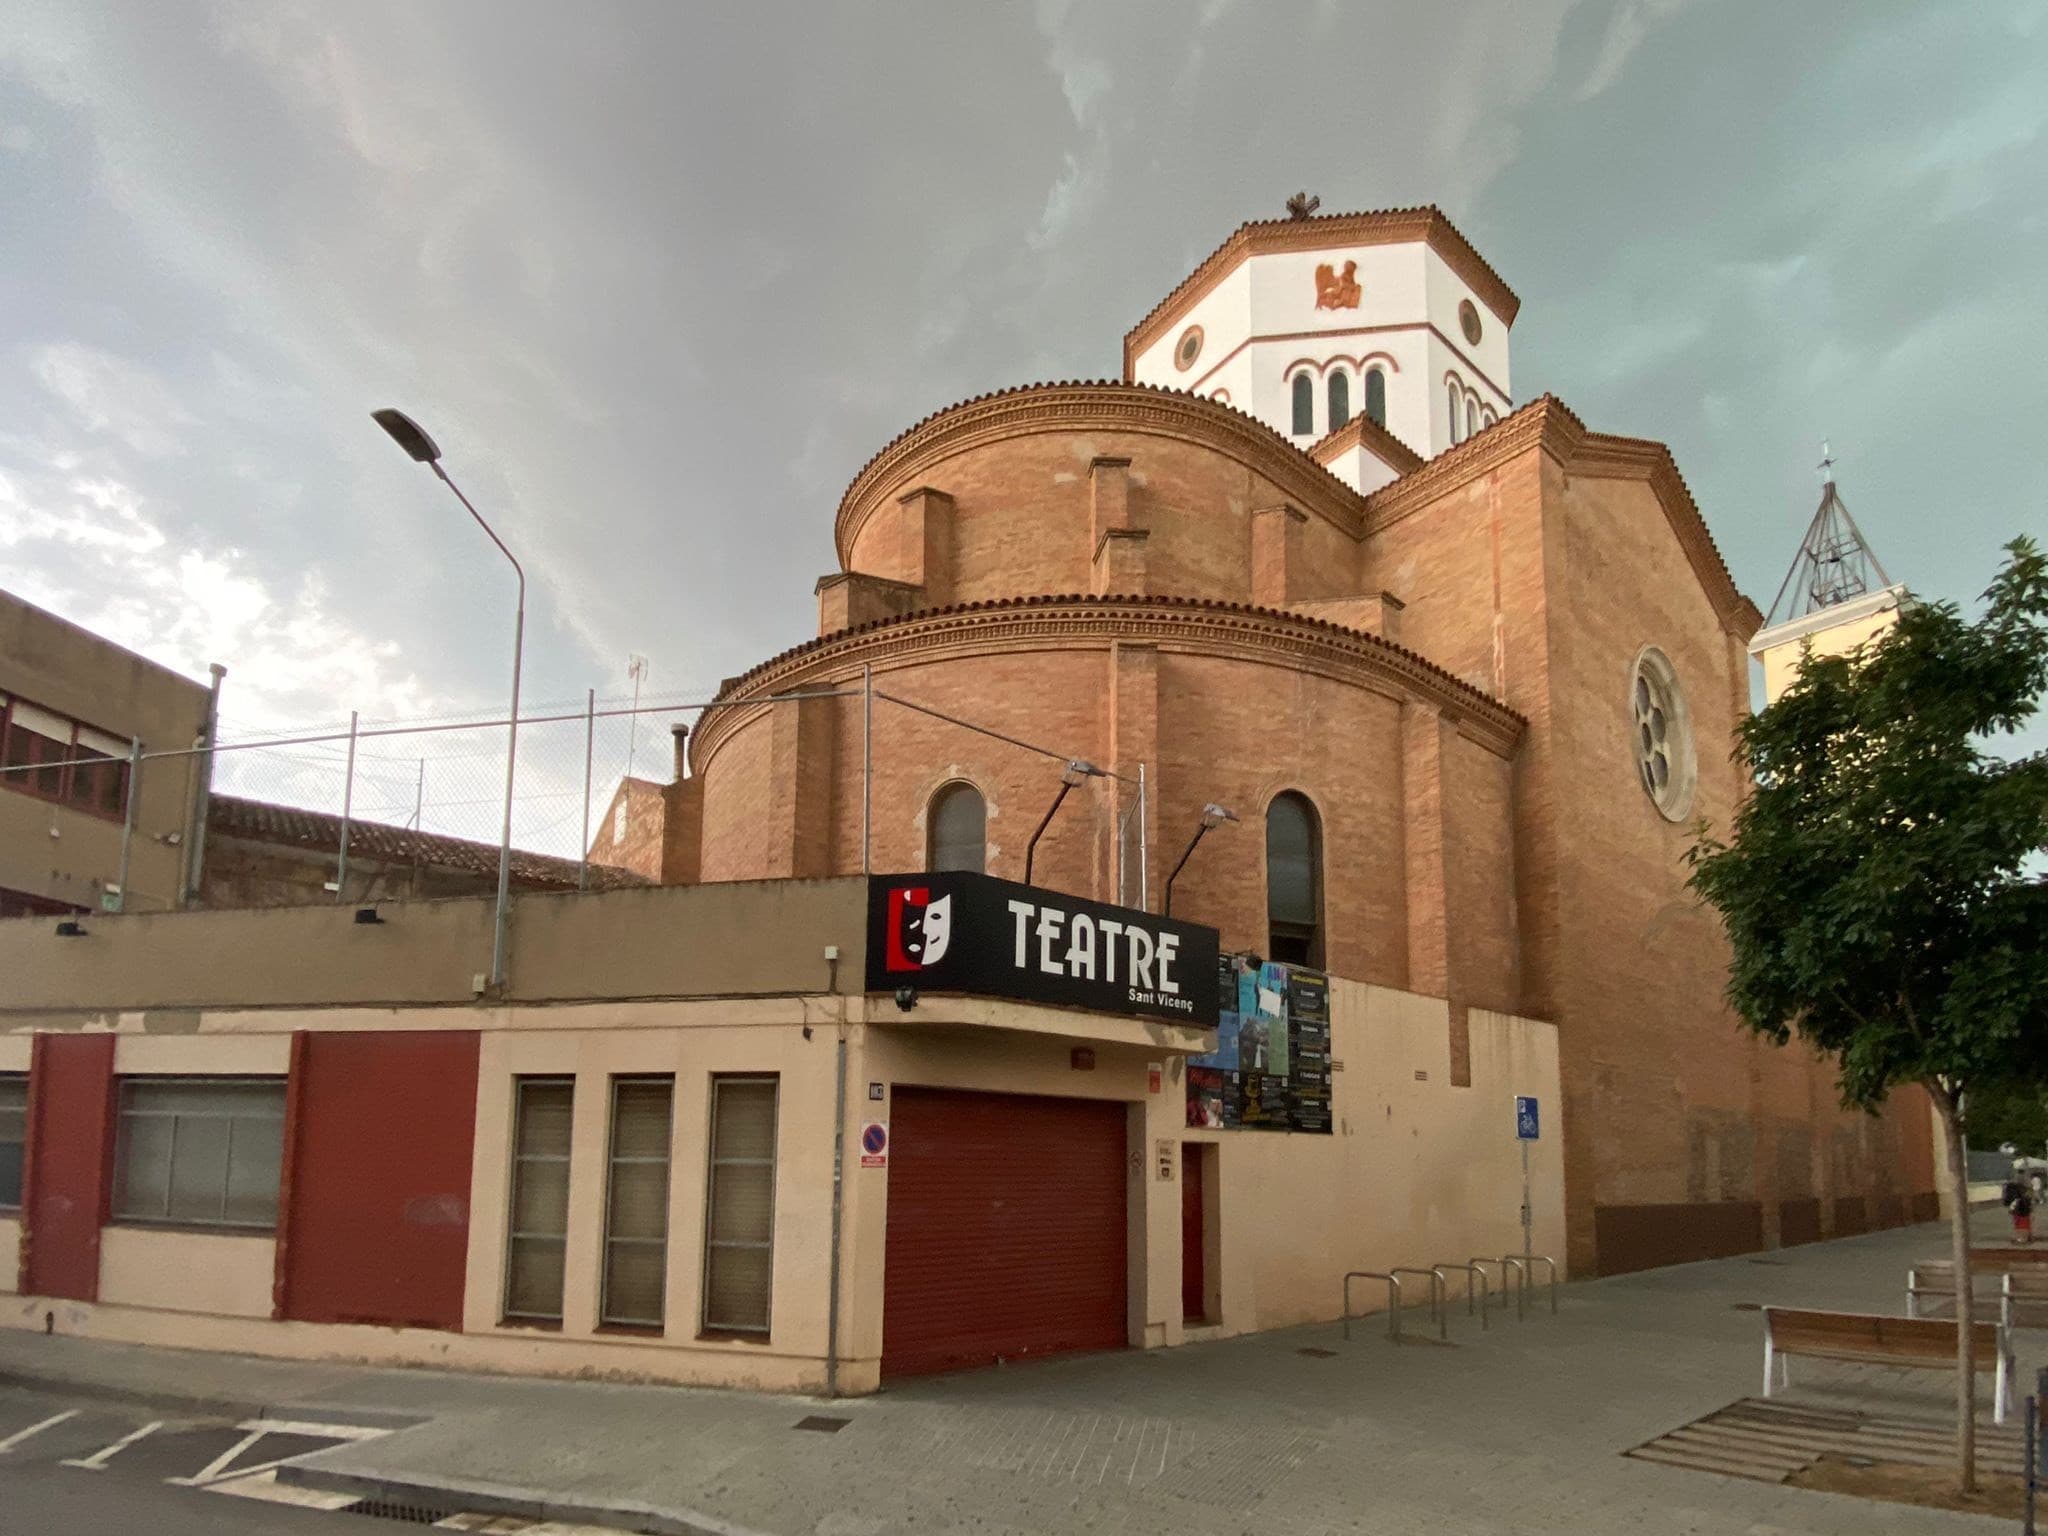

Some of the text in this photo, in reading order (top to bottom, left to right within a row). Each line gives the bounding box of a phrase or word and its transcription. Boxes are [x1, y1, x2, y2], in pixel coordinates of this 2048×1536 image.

[1008, 899, 1180, 994] TEATRE
[1128, 988, 1194, 1013] Sant Vicenç
